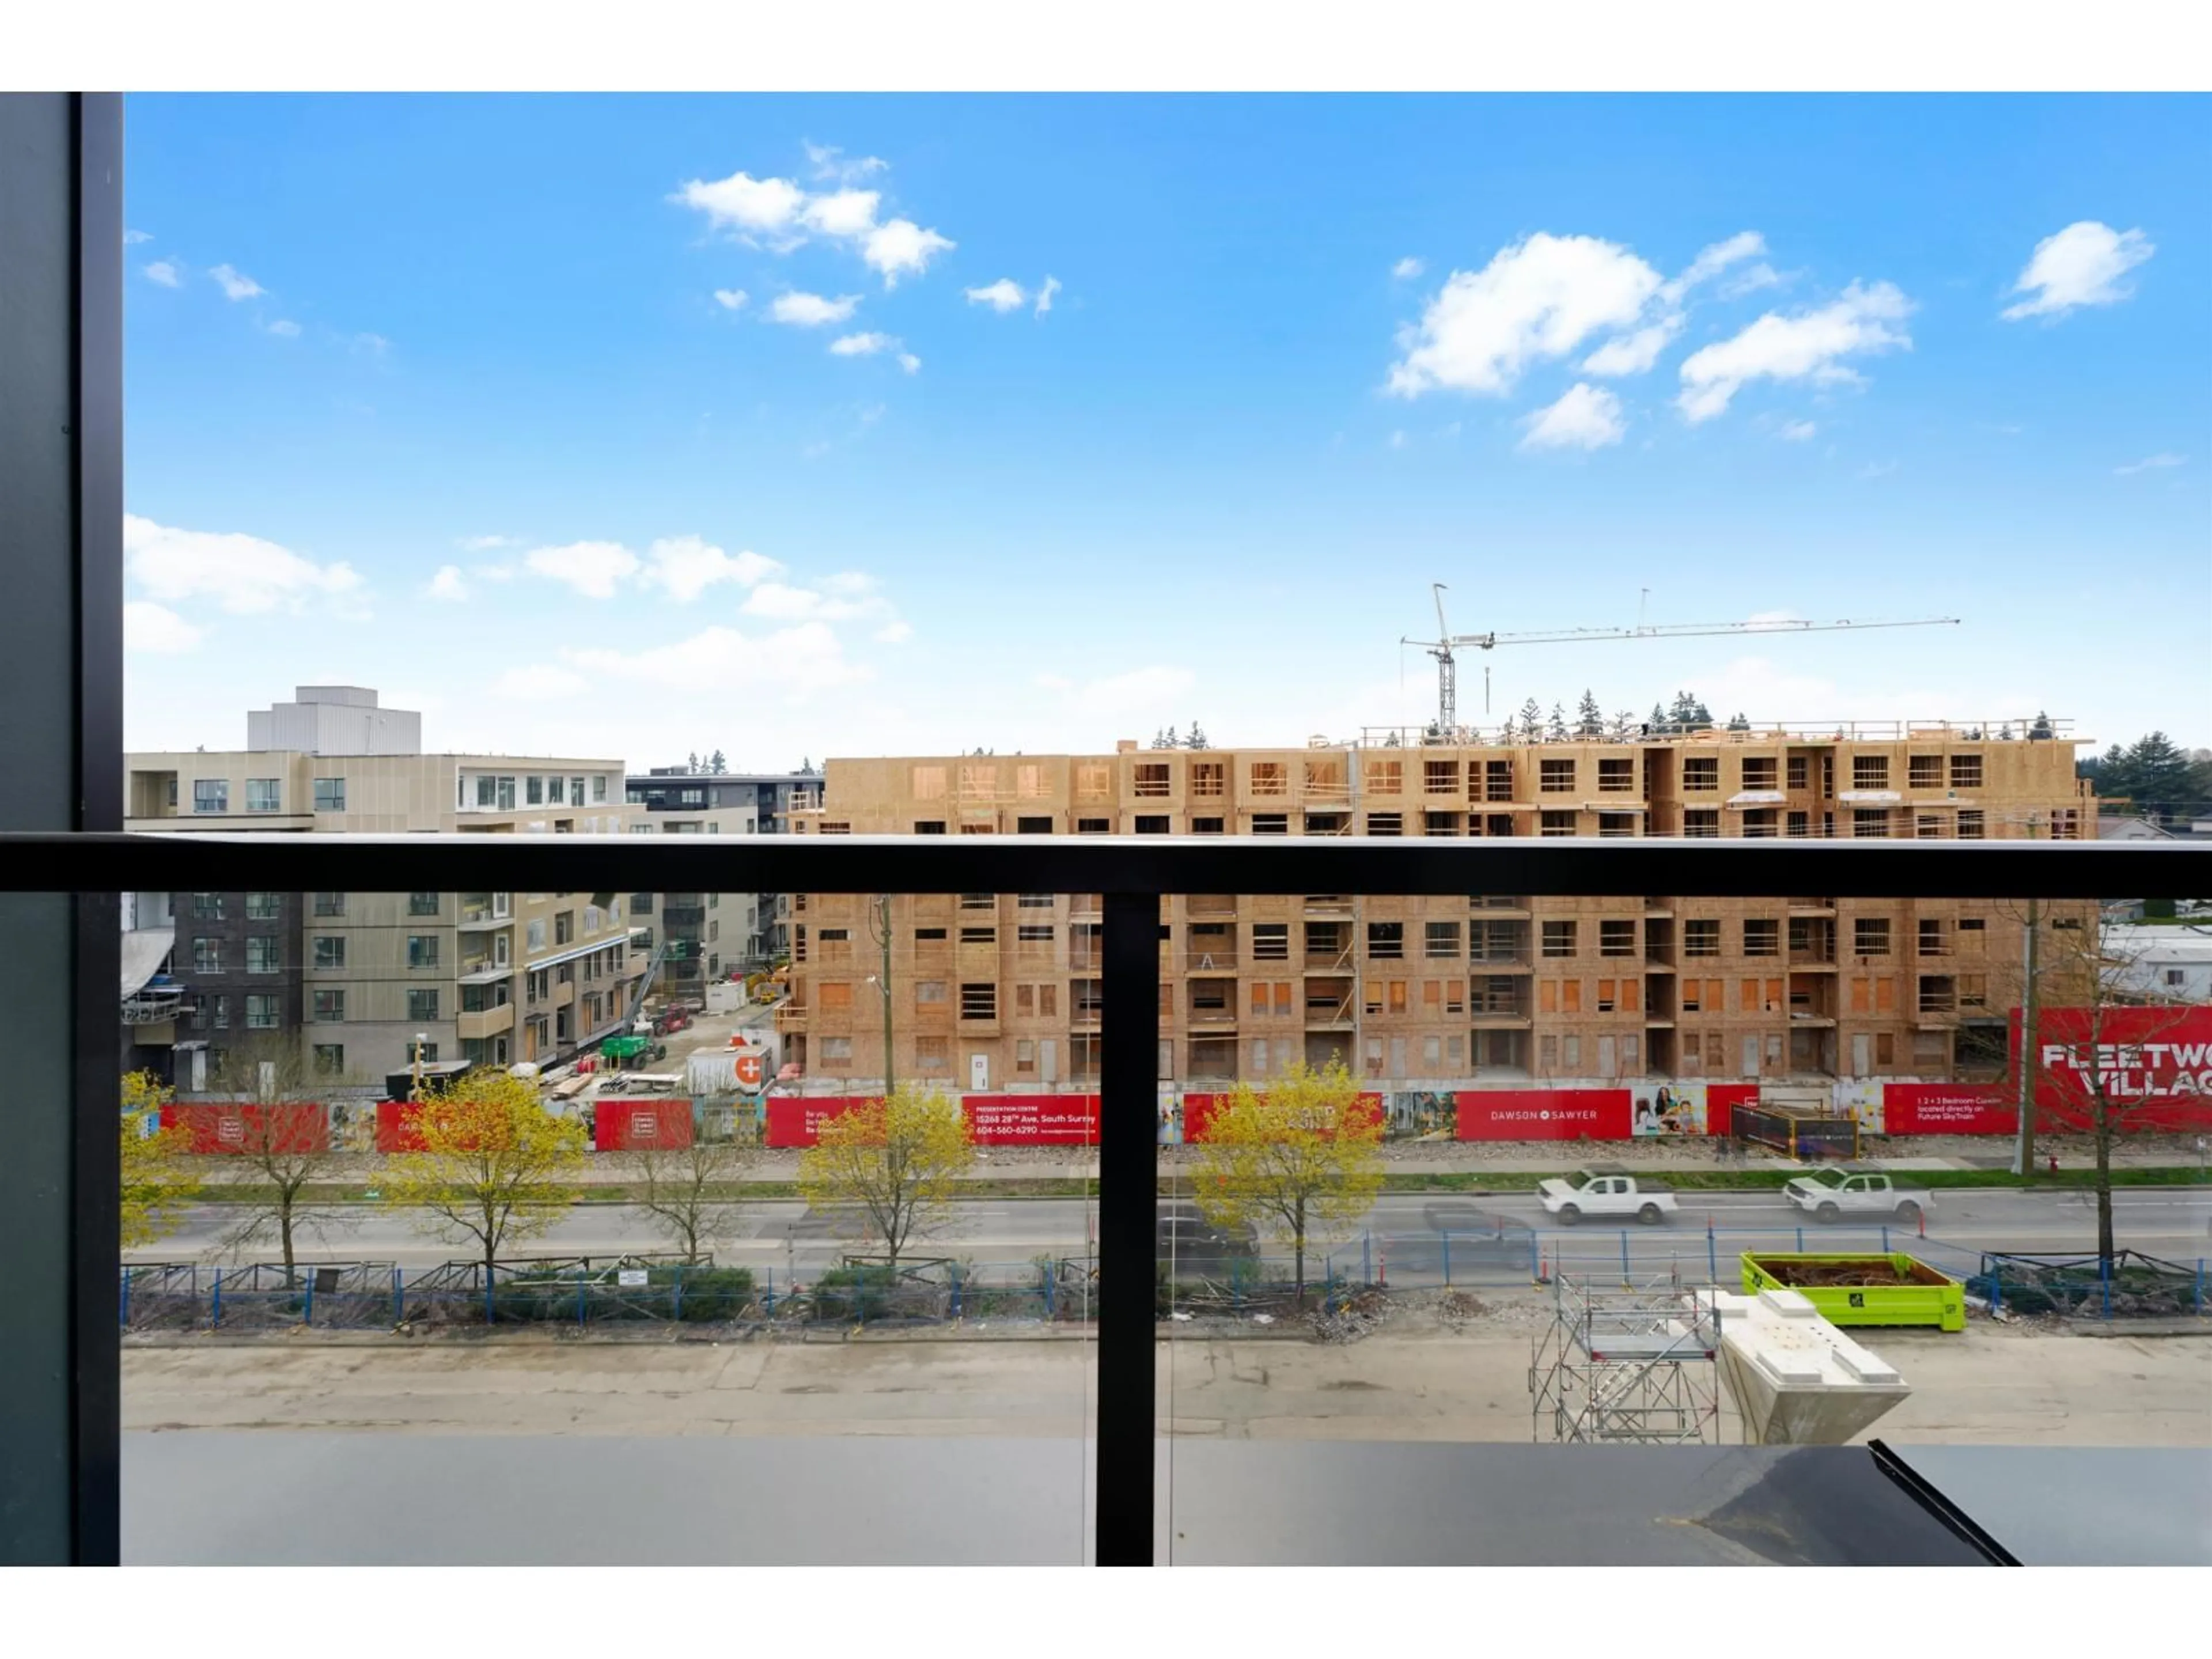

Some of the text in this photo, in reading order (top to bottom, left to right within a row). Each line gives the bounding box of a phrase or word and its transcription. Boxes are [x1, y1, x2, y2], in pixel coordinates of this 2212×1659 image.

[2043, 1044, 2212, 1069] FLEETW
[1041, 1113, 1065, 1123] South
[1067, 1114, 1095, 1124] Surrey
[1491, 1110, 1597, 1120] DAWSON SAWYER
